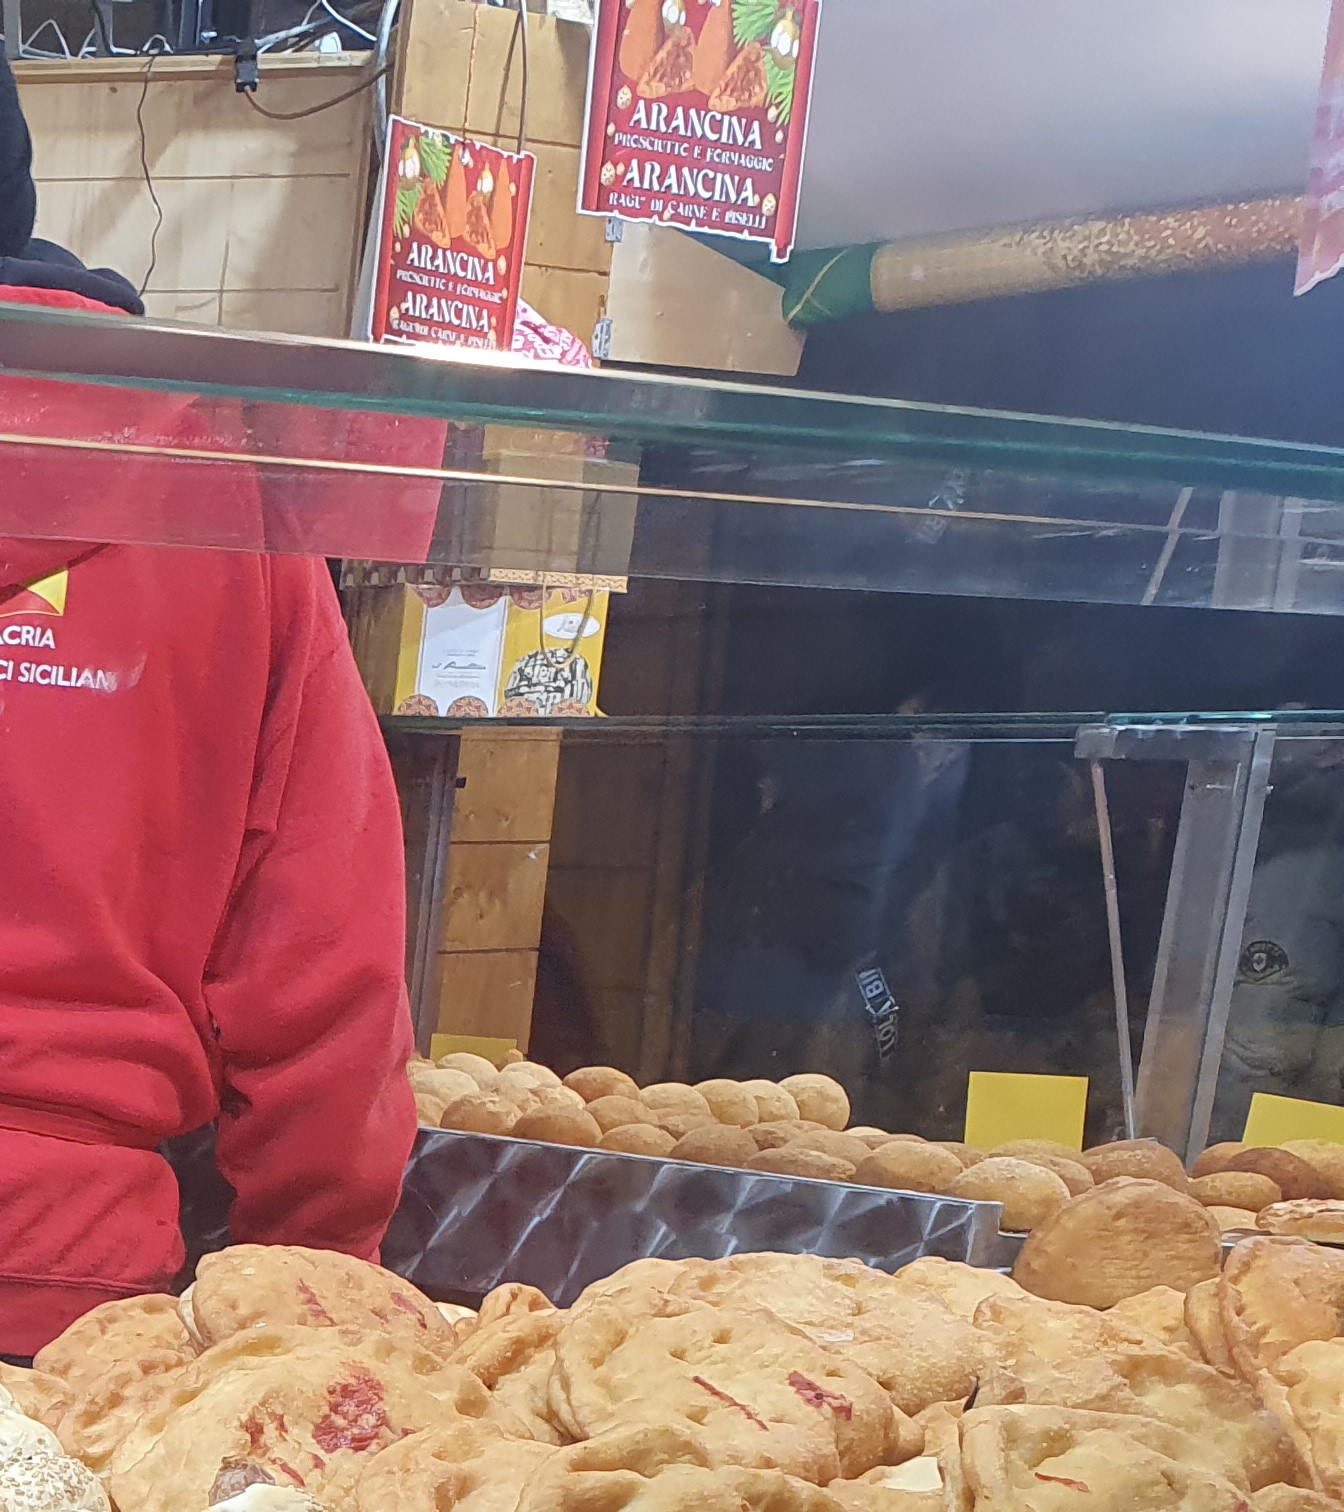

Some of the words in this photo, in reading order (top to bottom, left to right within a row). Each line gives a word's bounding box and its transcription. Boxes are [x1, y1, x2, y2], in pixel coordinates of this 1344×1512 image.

[629, 99, 762, 150] ARANCINA
[622, 158, 757, 207] ARANCINA
[406, 242, 495, 285] ARANCINA
[403, 291, 489, 333] ARANCINA
